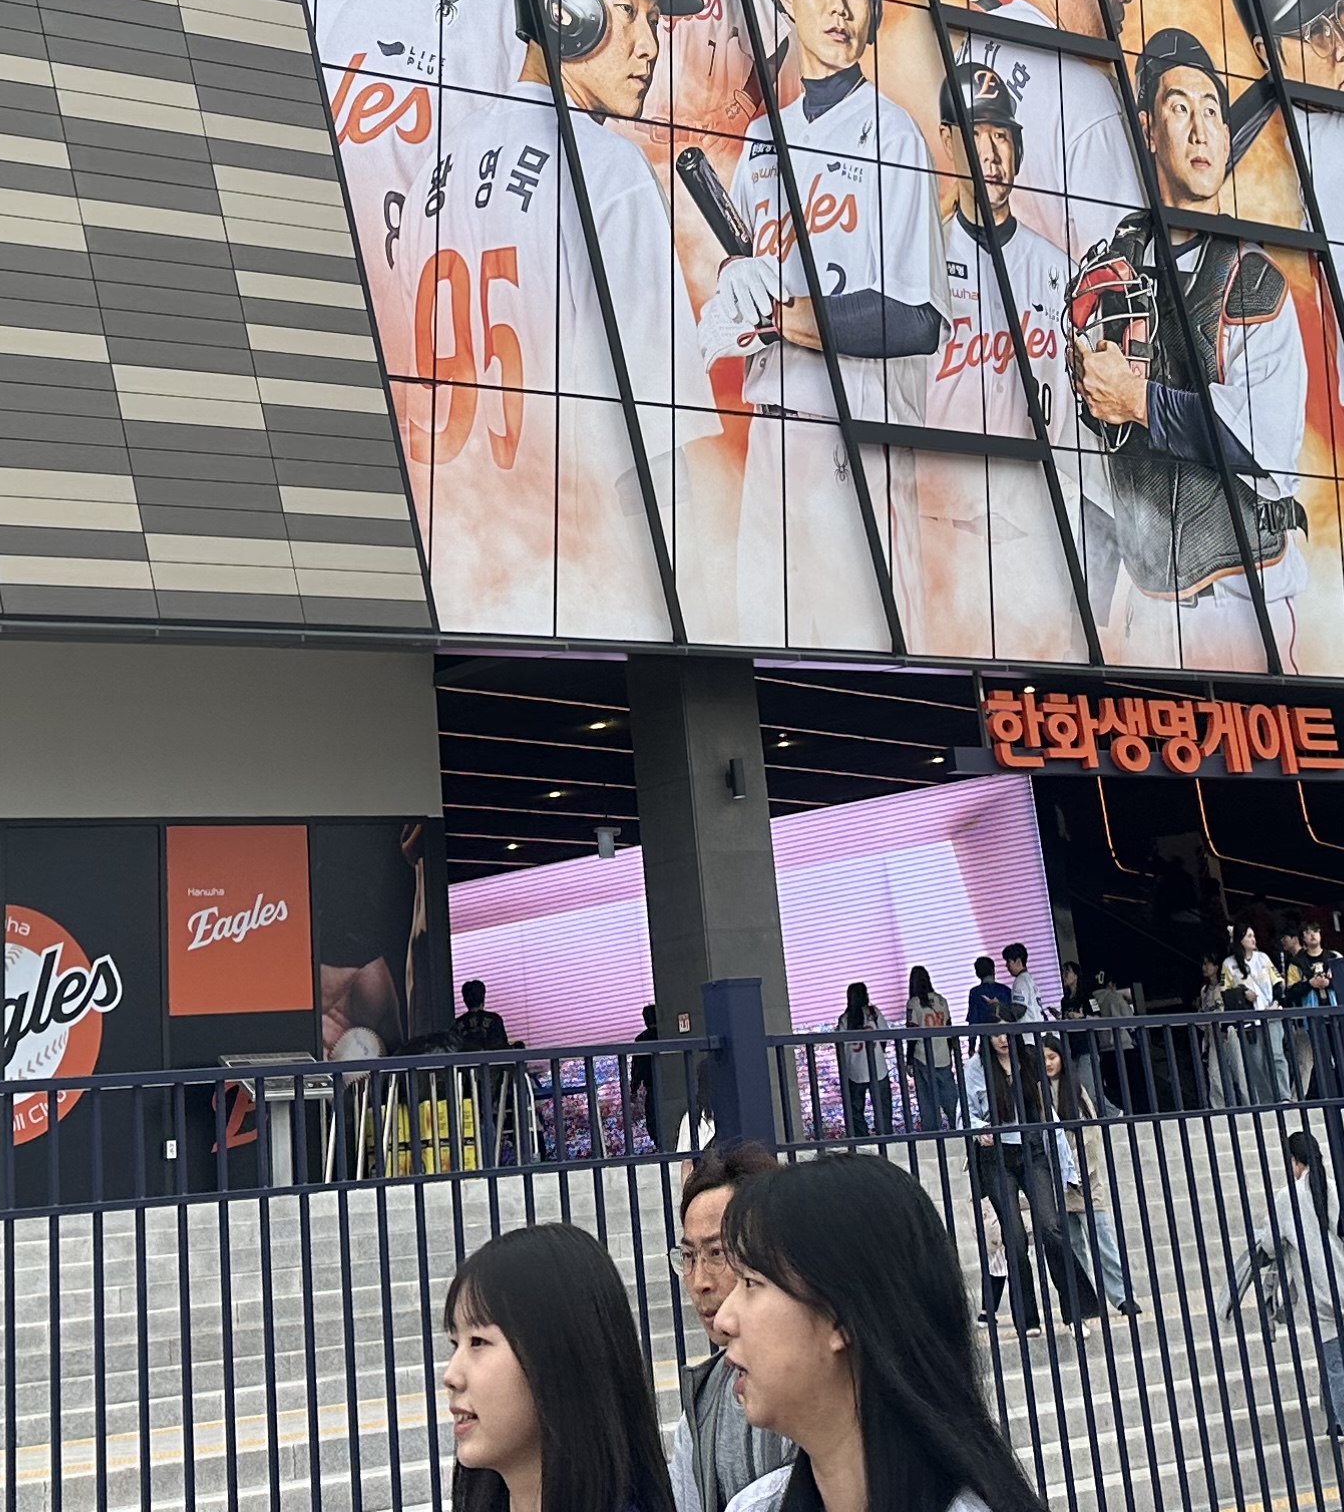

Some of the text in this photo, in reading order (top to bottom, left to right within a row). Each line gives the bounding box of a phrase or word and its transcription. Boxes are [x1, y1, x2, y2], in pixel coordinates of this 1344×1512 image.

[410, 246, 524, 469] 95
[187, 887, 225, 897] Hanwha
[187, 893, 289, 951] Eagles
